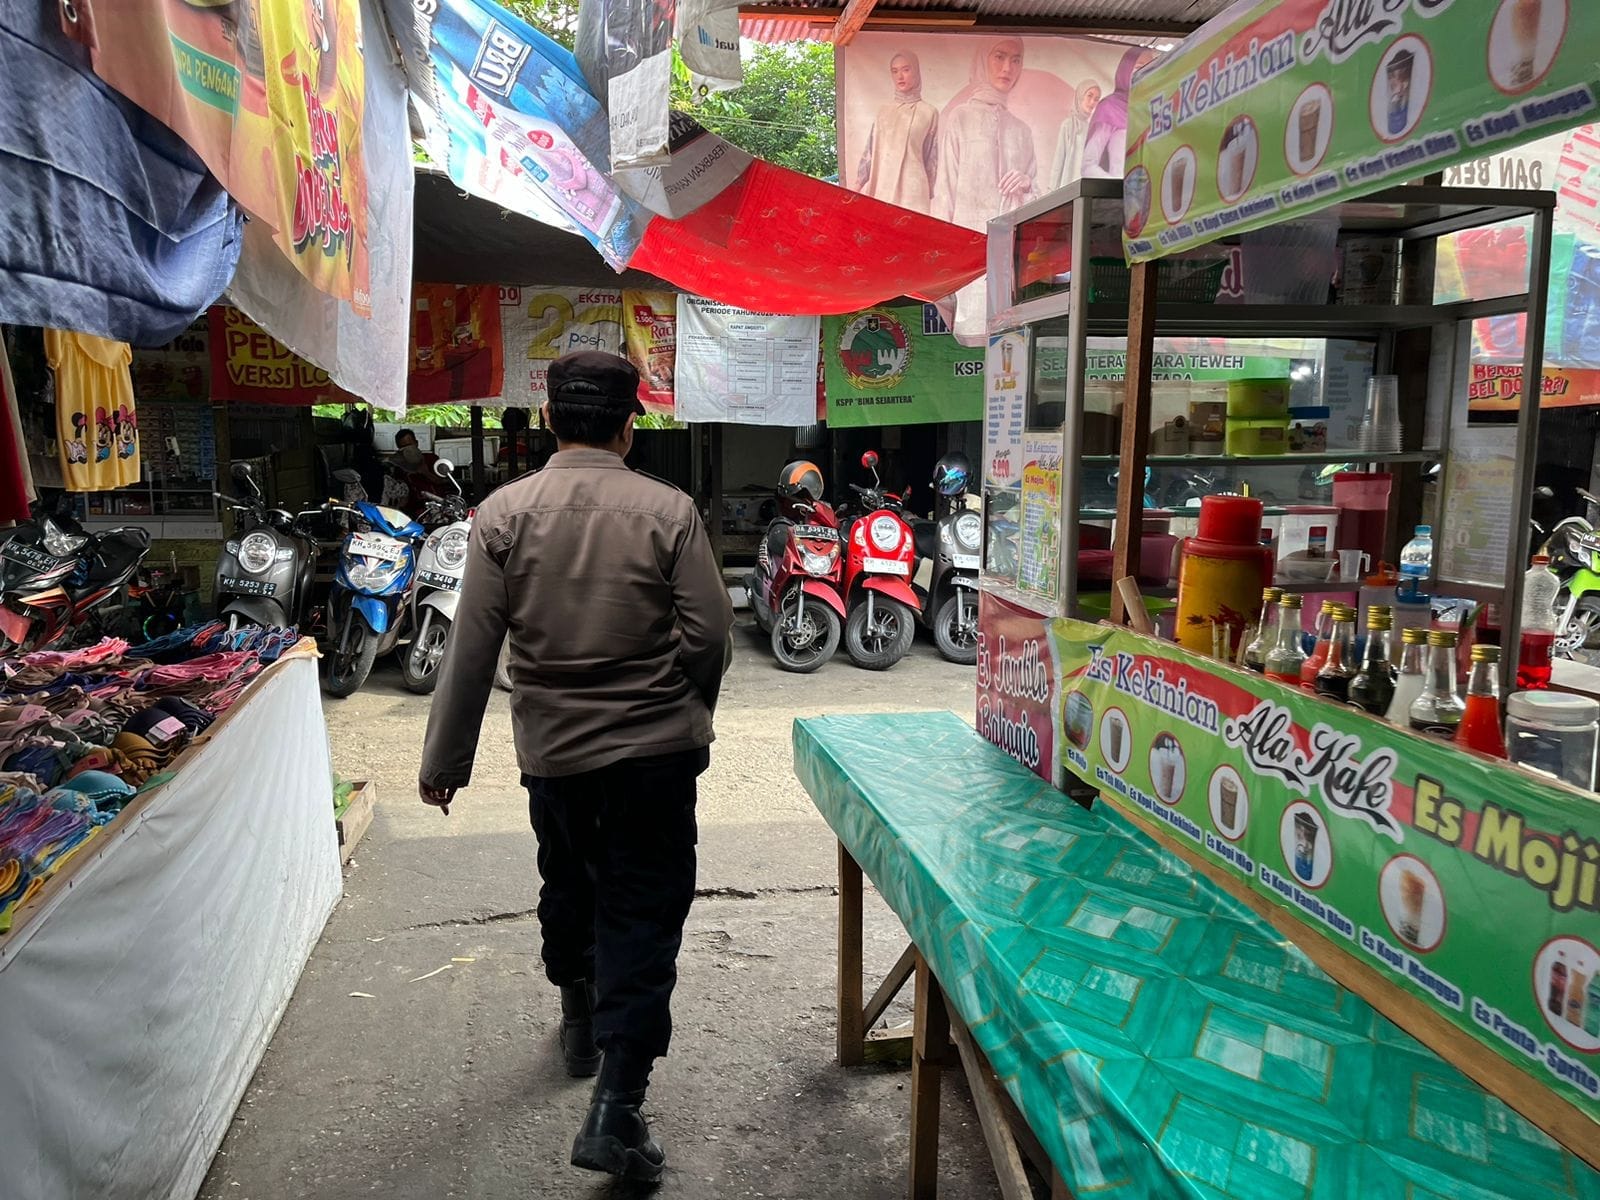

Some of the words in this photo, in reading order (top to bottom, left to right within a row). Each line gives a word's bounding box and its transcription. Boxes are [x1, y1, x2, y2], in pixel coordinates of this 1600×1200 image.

[1150, 96, 1172, 137] Es
[1177, 31, 1295, 123] Kekinian
[1467, 124, 1484, 142] Es
[1485, 113, 1519, 137] Kopi
[1345, 169, 1359, 182] Es
[1359, 157, 1385, 176] Kopi
[1292, 183, 1315, 199] Kopi
[1204, 215, 1220, 231] Kopi
[1239, 197, 1276, 217] Kekinian
[578, 294, 623, 304] EKSTRA
[701, 307, 731, 315] PERIODE
[229, 331, 291, 361] PED
[568, 332, 606, 349] posh
[1154, 355, 1184, 369] ARA
[1189, 355, 1244, 369] TEWEH
[229, 365, 292, 387] VERSI
[836, 398, 854, 407] KSPP
[1470, 382, 1496, 398] BEL
[7, 543, 19, 552] KH
[238, 580, 260, 589] 5253
[263, 583, 275, 591] ES
[980, 697, 1040, 767] Bahagia
[1087, 646, 1112, 682] Es
[1115, 653, 1219, 733] Kekinian
[1225, 706, 1303, 786] Ala
[1295, 730, 1394, 833] Kafe
[1097, 768, 1105, 778] Es
[1104, 770, 1114, 786] Teh
[1129, 787, 1137, 799] Es
[1137, 791, 1152, 809] Kopi
[1152, 800, 1168, 819] Susu
[1168, 808, 1201, 839] Kekinian
[1415, 775, 1463, 845] Es
[1207, 834, 1216, 847] Es
[1216, 839, 1235, 859] Kopi
[1261, 866, 1271, 882] Es
[1271, 872, 1293, 896] Kopi
[1327, 907, 1353, 936] Blue
[1362, 932, 1375, 952] Es
[1376, 941, 1404, 970] Kopi
[1408, 961, 1460, 1006] Mangga
[1475, 1002, 1491, 1025] Es
[1493, 1014, 1537, 1055] Panta
[1547, 1048, 1599, 1094] Sprite
